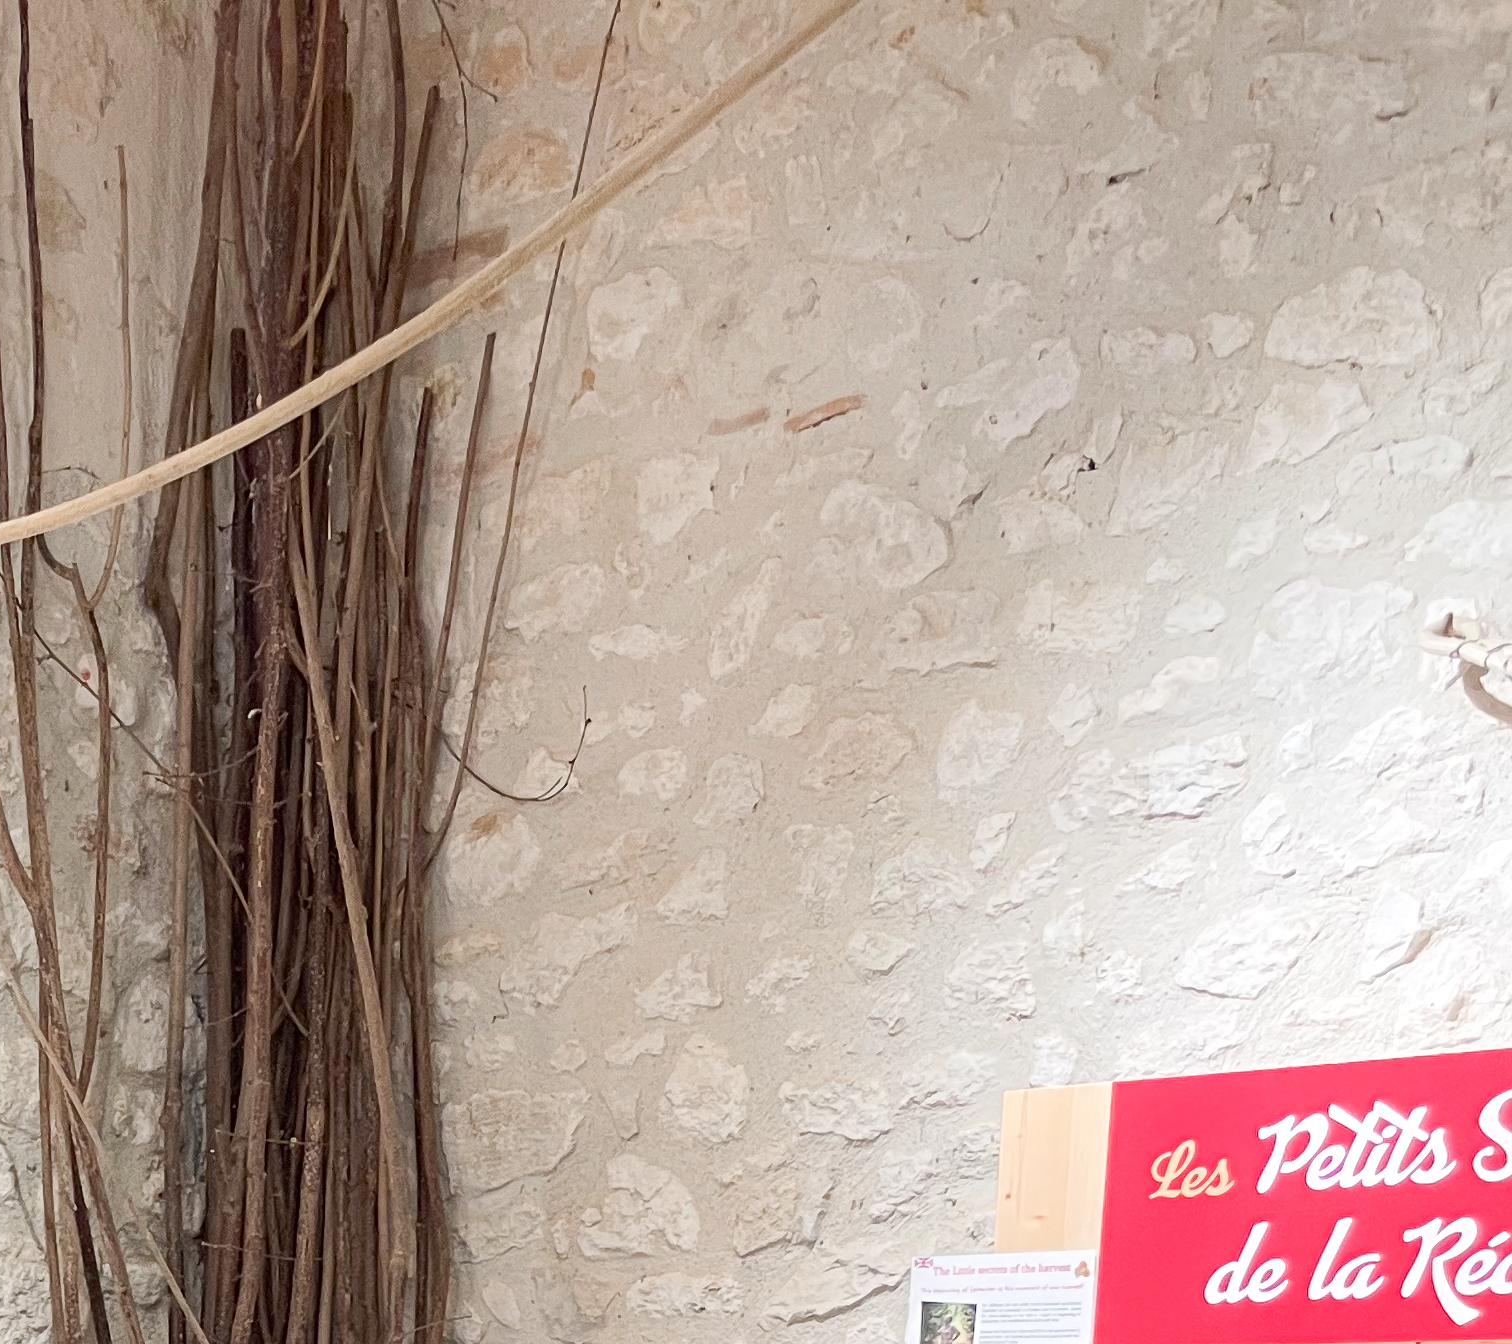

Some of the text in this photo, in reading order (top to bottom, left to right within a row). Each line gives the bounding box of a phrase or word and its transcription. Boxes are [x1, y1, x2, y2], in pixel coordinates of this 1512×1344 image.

[1149, 1140, 1235, 1200] Les
[1257, 1100, 1457, 1194] Petits
[1204, 1221, 1289, 1304] de
[1308, 1218, 1383, 1301] la
